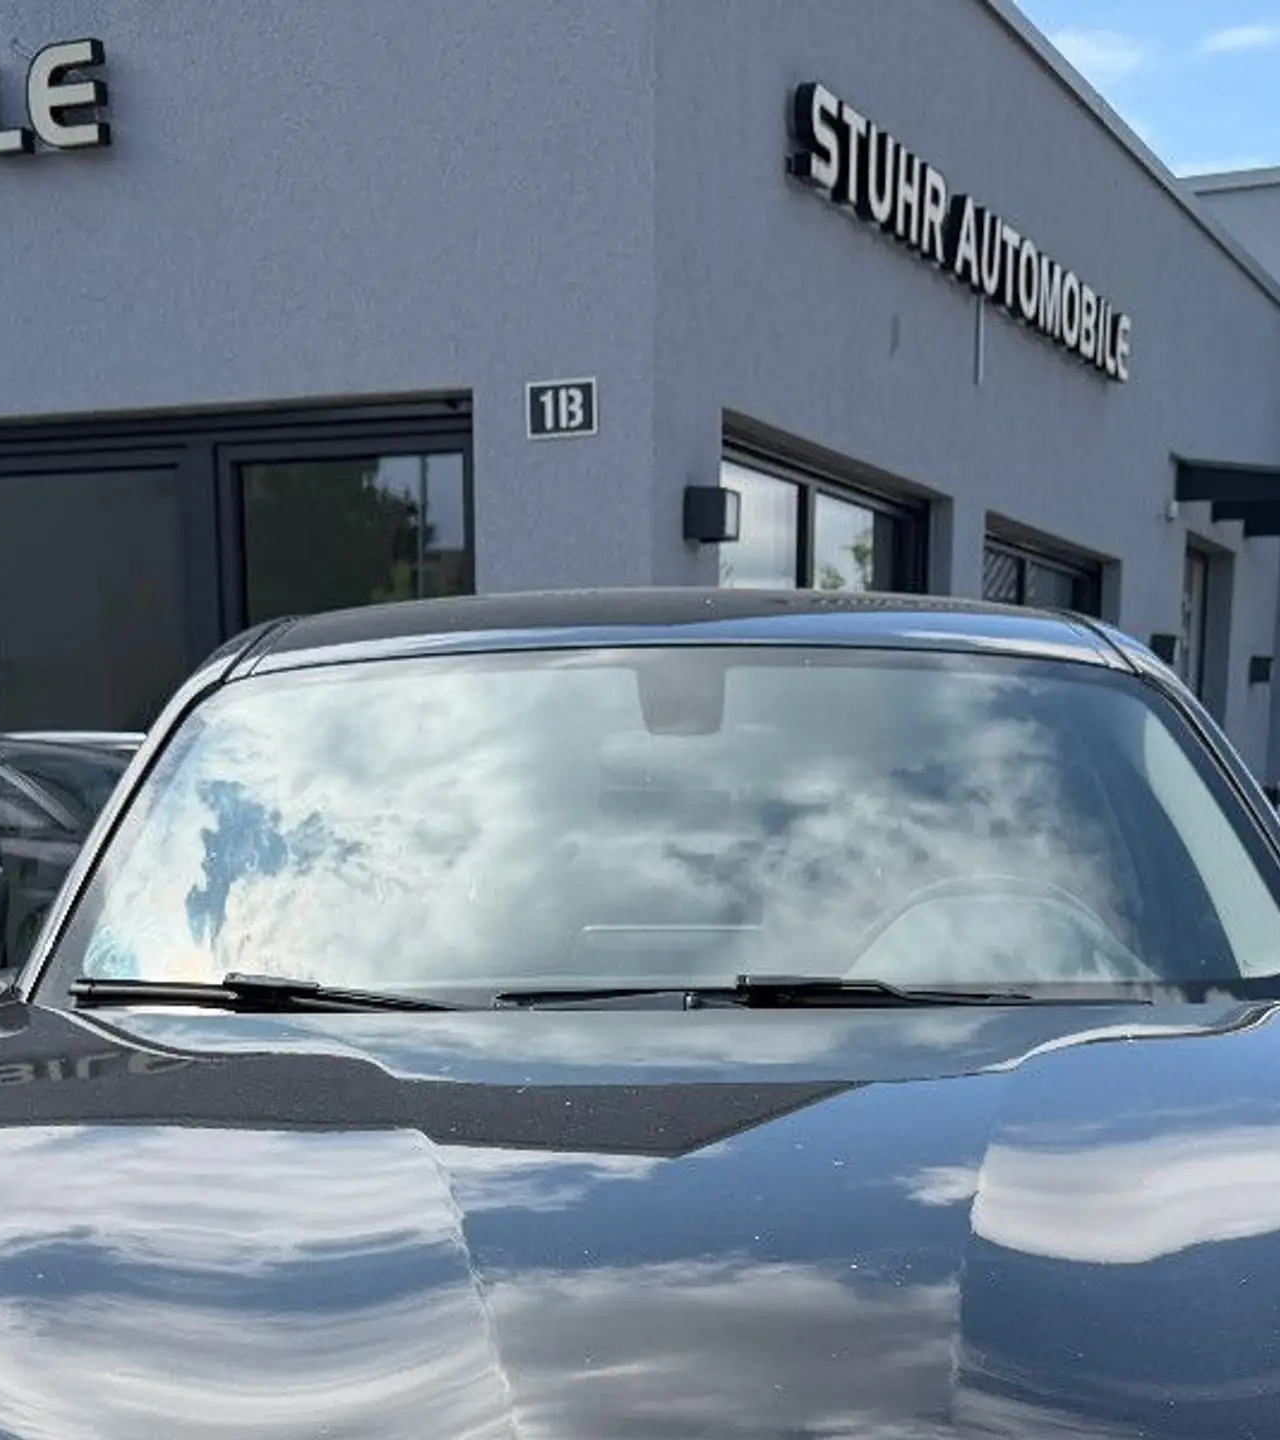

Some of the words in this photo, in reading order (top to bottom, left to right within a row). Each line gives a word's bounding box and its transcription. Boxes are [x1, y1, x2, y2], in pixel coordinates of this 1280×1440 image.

[798, 82, 948, 264] STUHR
[954, 195, 1131, 383] AUTOMOBILE
[539, 387, 585, 431] 1B
